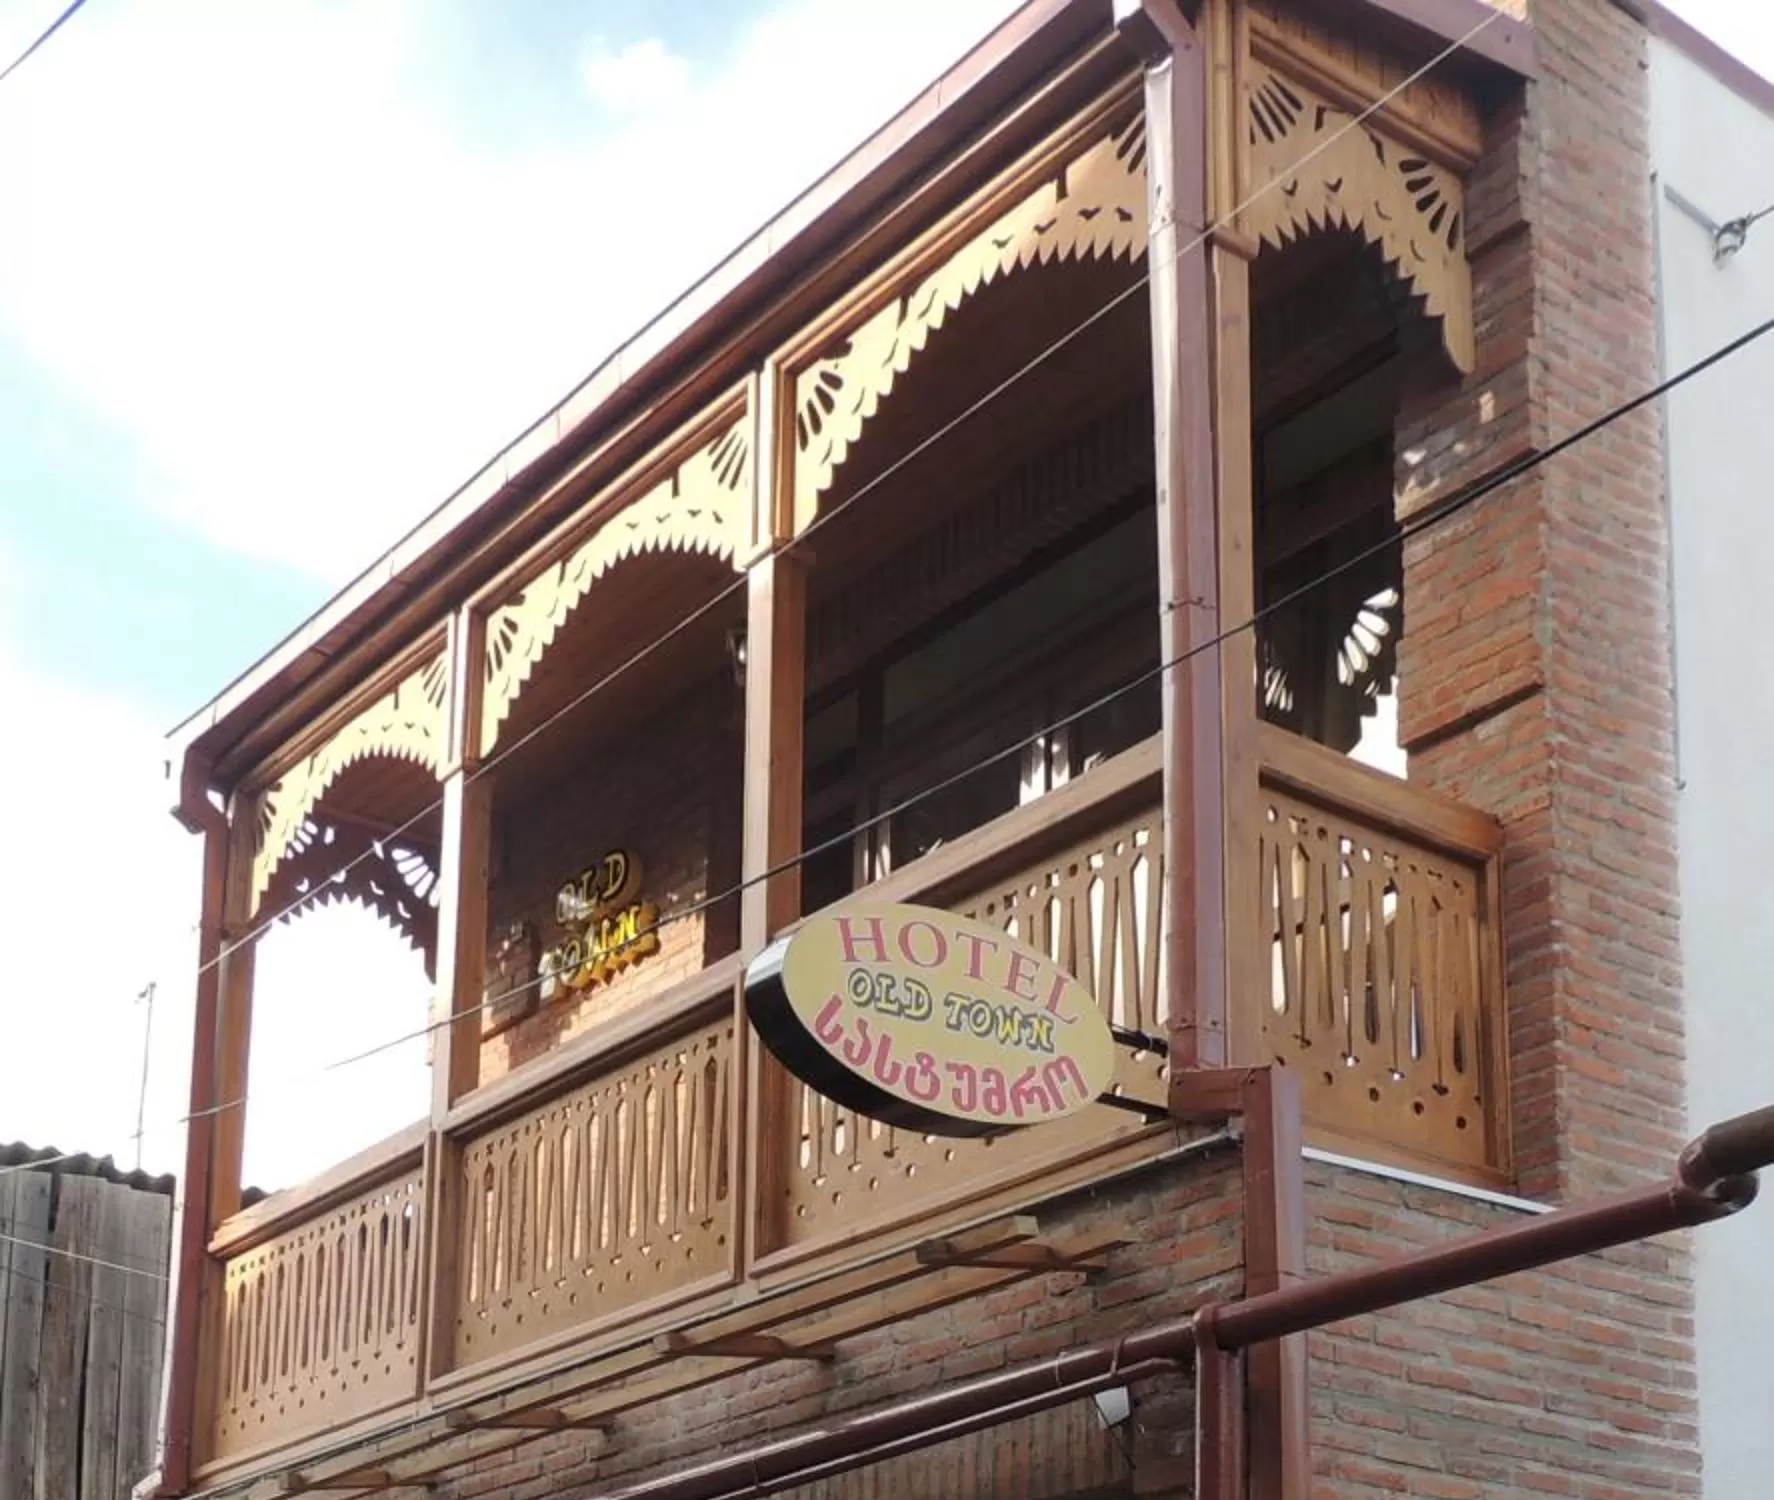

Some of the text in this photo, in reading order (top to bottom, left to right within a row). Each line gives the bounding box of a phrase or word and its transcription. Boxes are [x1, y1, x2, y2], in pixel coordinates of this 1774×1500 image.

[555, 851, 630, 925] OLD
[538, 903, 642, 1000] TOWN
[833, 916, 1080, 1025] HOTEL
[814, 994, 1089, 1118] სასტუმრო
[847, 967, 1056, 1053] OLD TOWN
